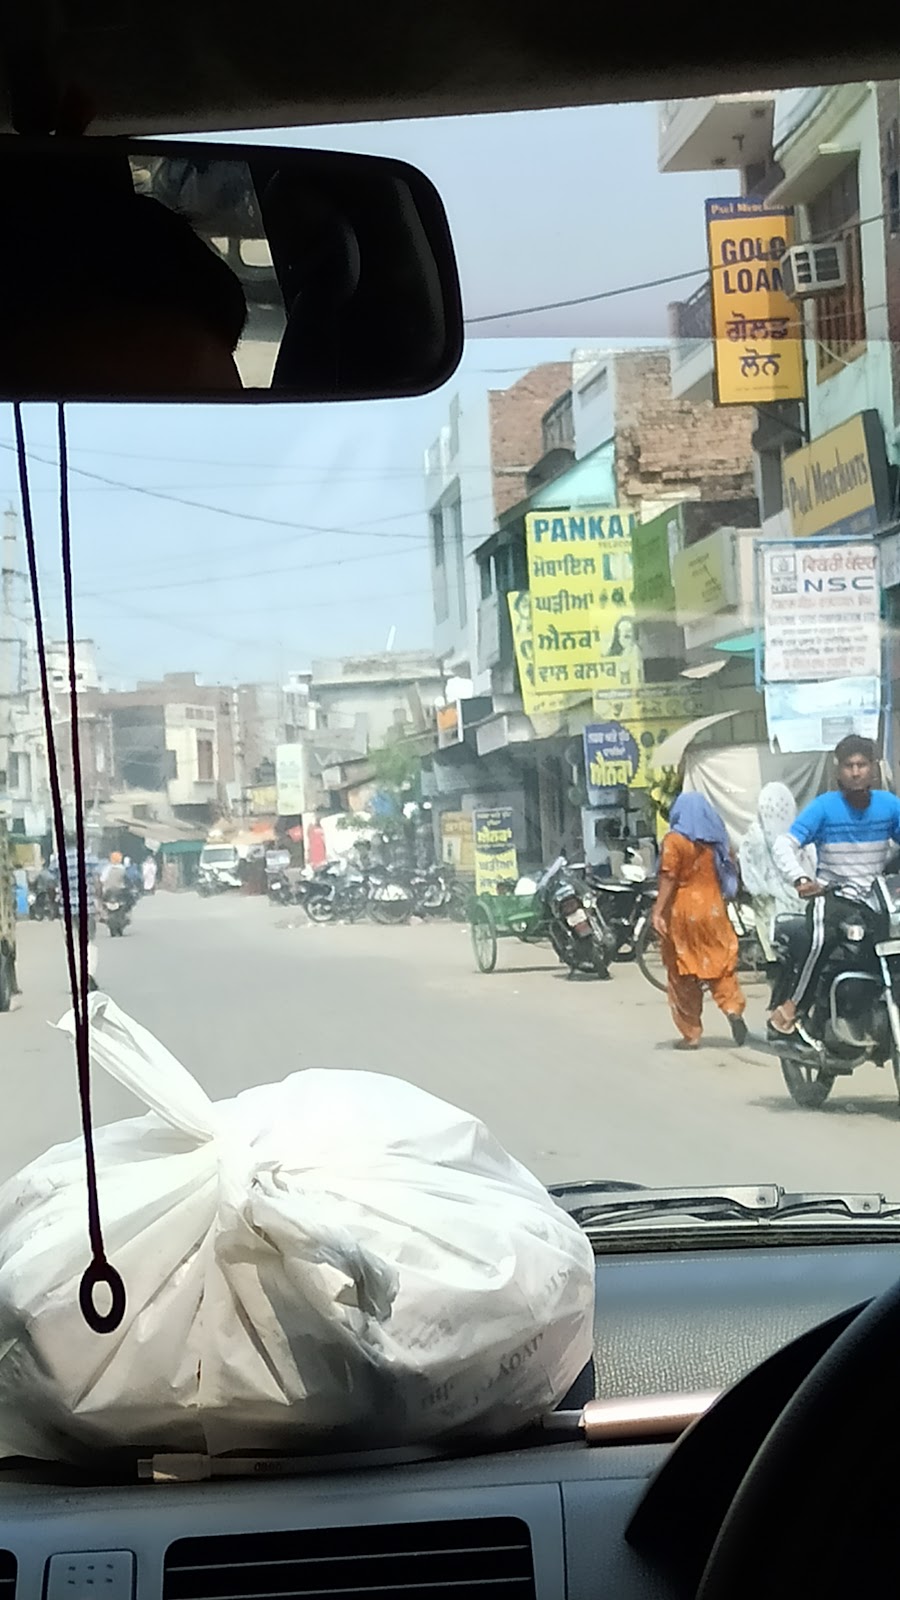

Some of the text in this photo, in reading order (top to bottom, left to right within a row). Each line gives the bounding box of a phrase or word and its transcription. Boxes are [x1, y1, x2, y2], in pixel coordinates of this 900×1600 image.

[721, 235, 785, 263] GOLD
[725, 311, 790, 341] ਗੋਲਡ
[738, 347, 781, 377] ਲੋਨ
[804, 576, 874, 592] NSC
